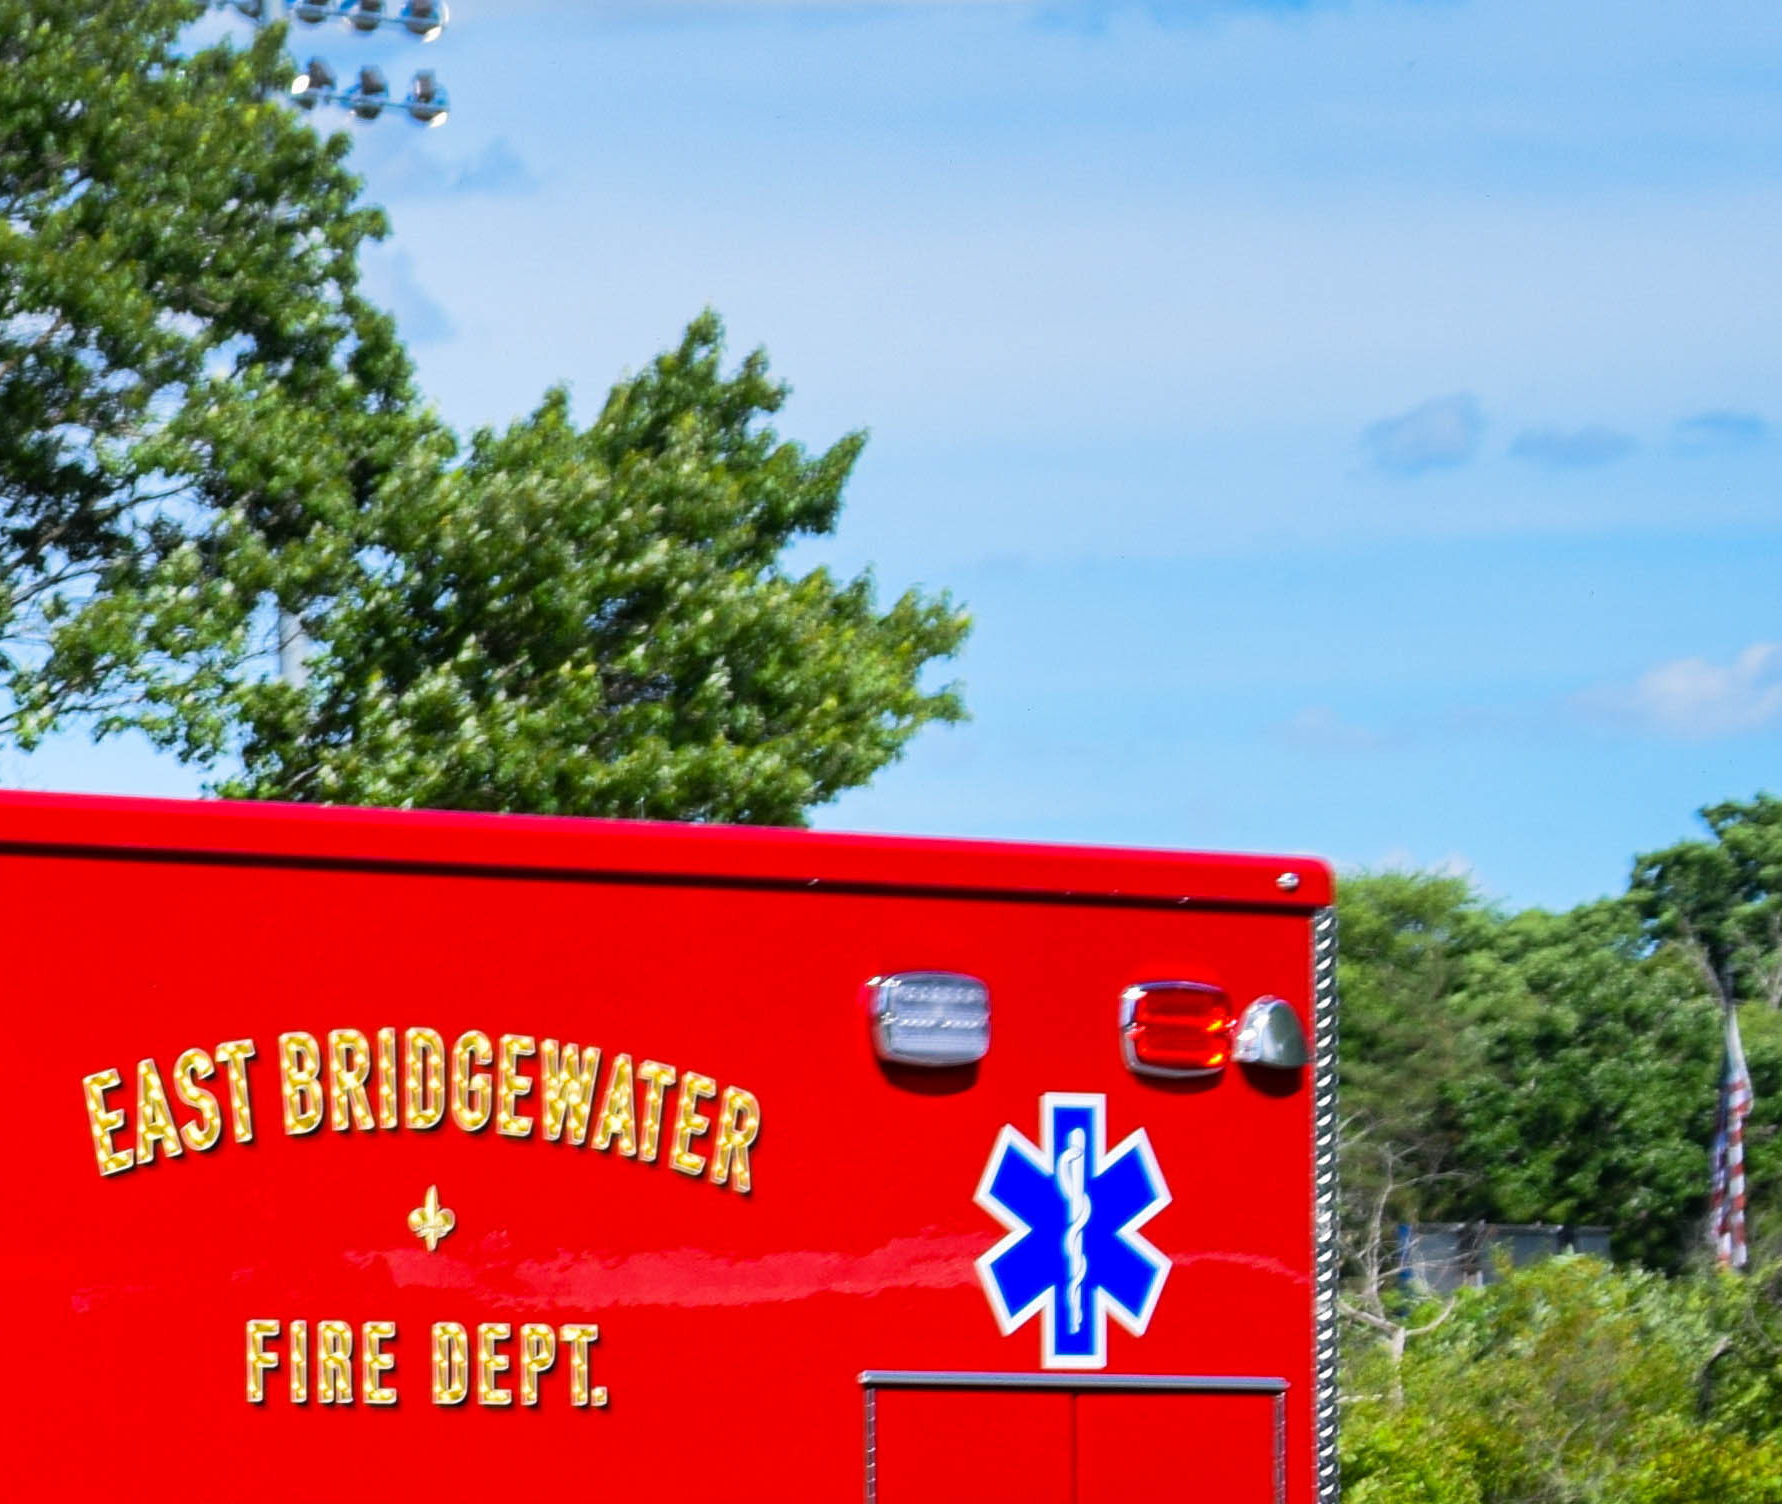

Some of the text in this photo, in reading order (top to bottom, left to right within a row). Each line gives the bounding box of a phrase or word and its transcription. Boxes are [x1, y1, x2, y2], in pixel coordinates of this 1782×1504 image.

[83, 1027, 761, 1192] EAST BRIDGEWATER
[246, 1320, 608, 1407] FIRE DEPT.
